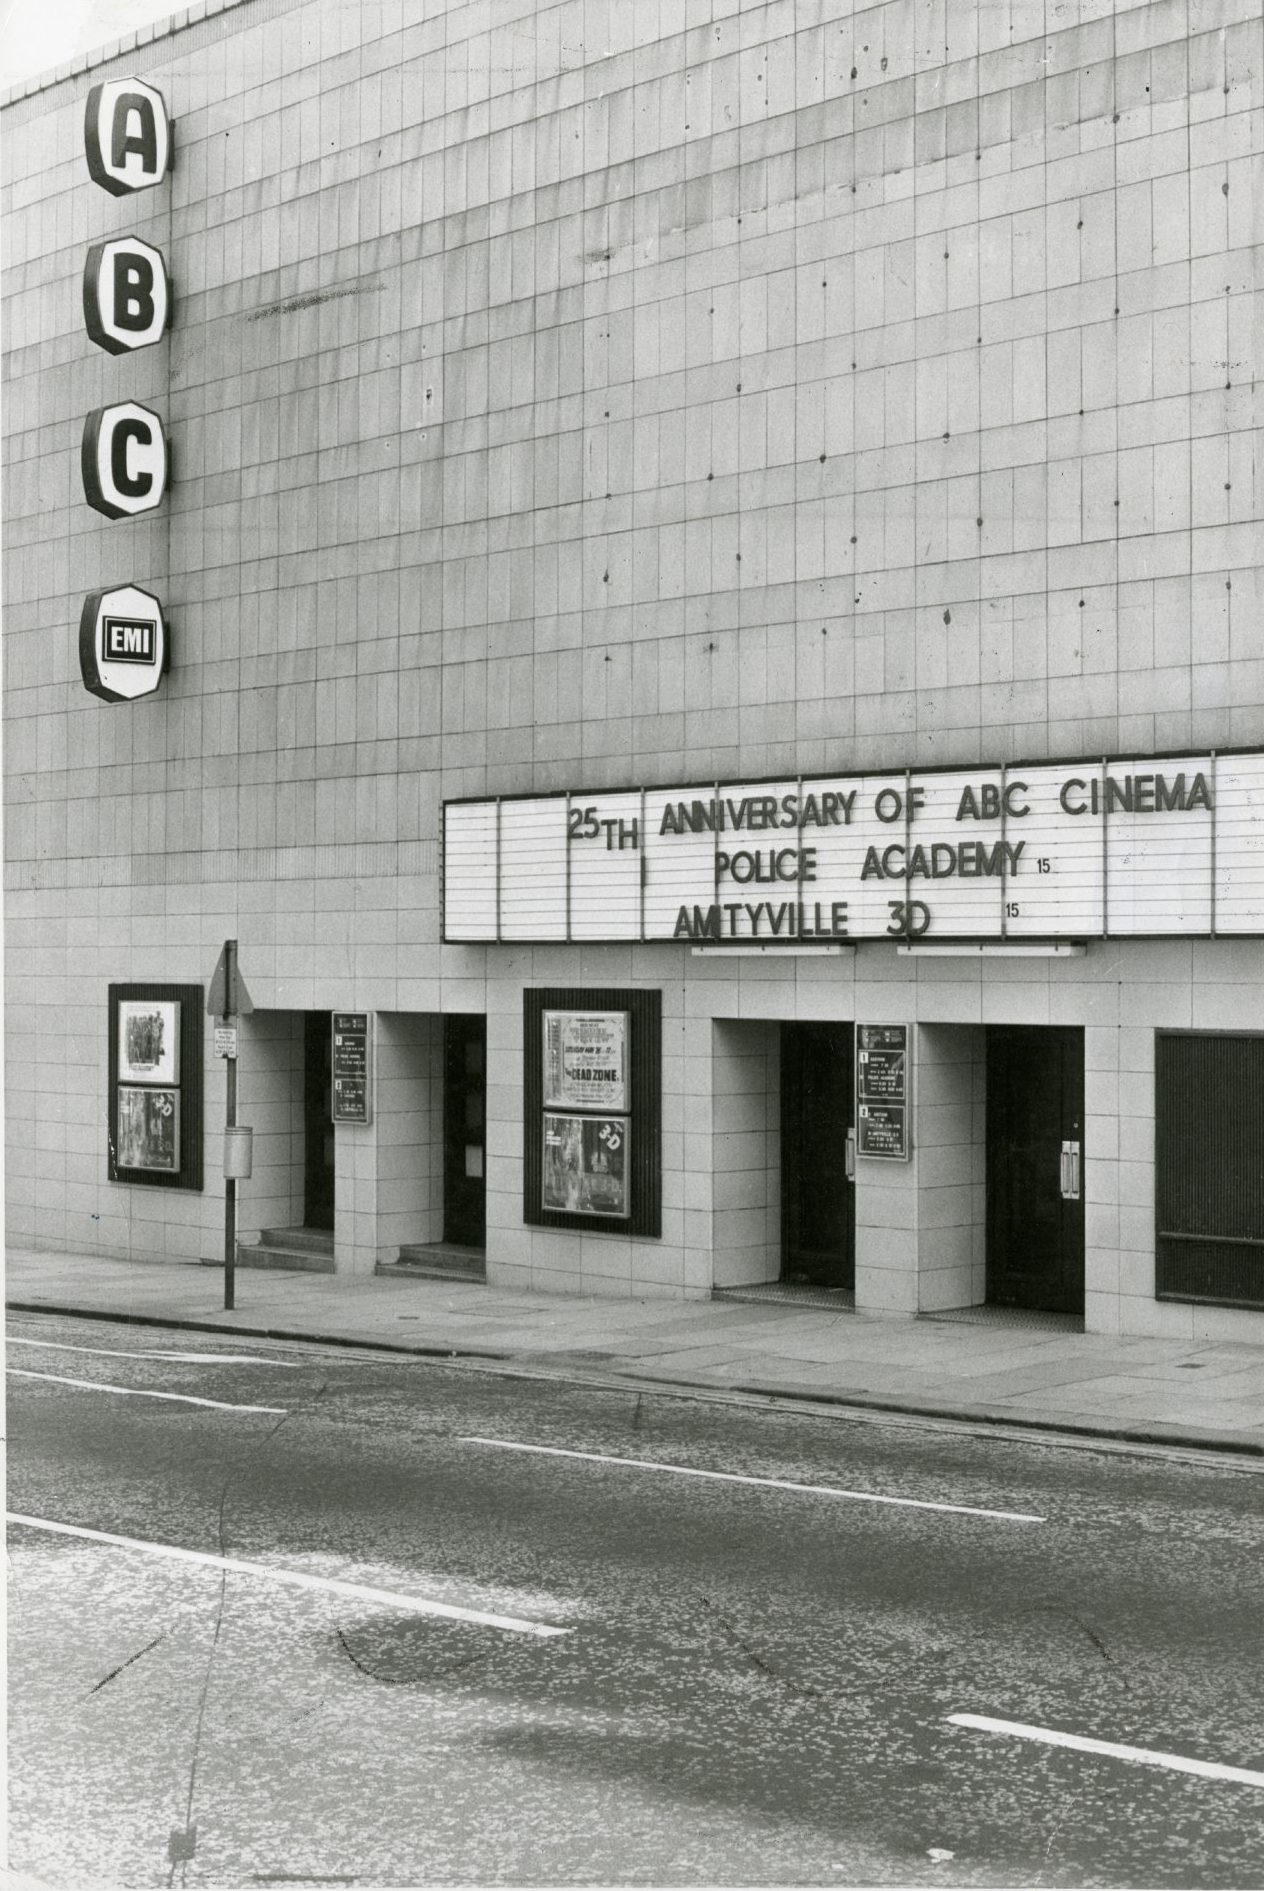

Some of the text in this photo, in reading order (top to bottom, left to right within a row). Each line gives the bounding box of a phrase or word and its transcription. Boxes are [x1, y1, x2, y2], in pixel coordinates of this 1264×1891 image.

[111, 626, 149, 653] EMI
[568, 772, 1213, 851] 25TH ANNIVERSARY OF ABC CINEMA
[715, 841, 1051, 884] POLICE ACADEMY 15
[887, 900, 931, 936] 3D
[1005, 903, 1019, 918] 15
[572, 1068, 592, 1081] DEAD
[599, 1124, 621, 1150] 3-D
